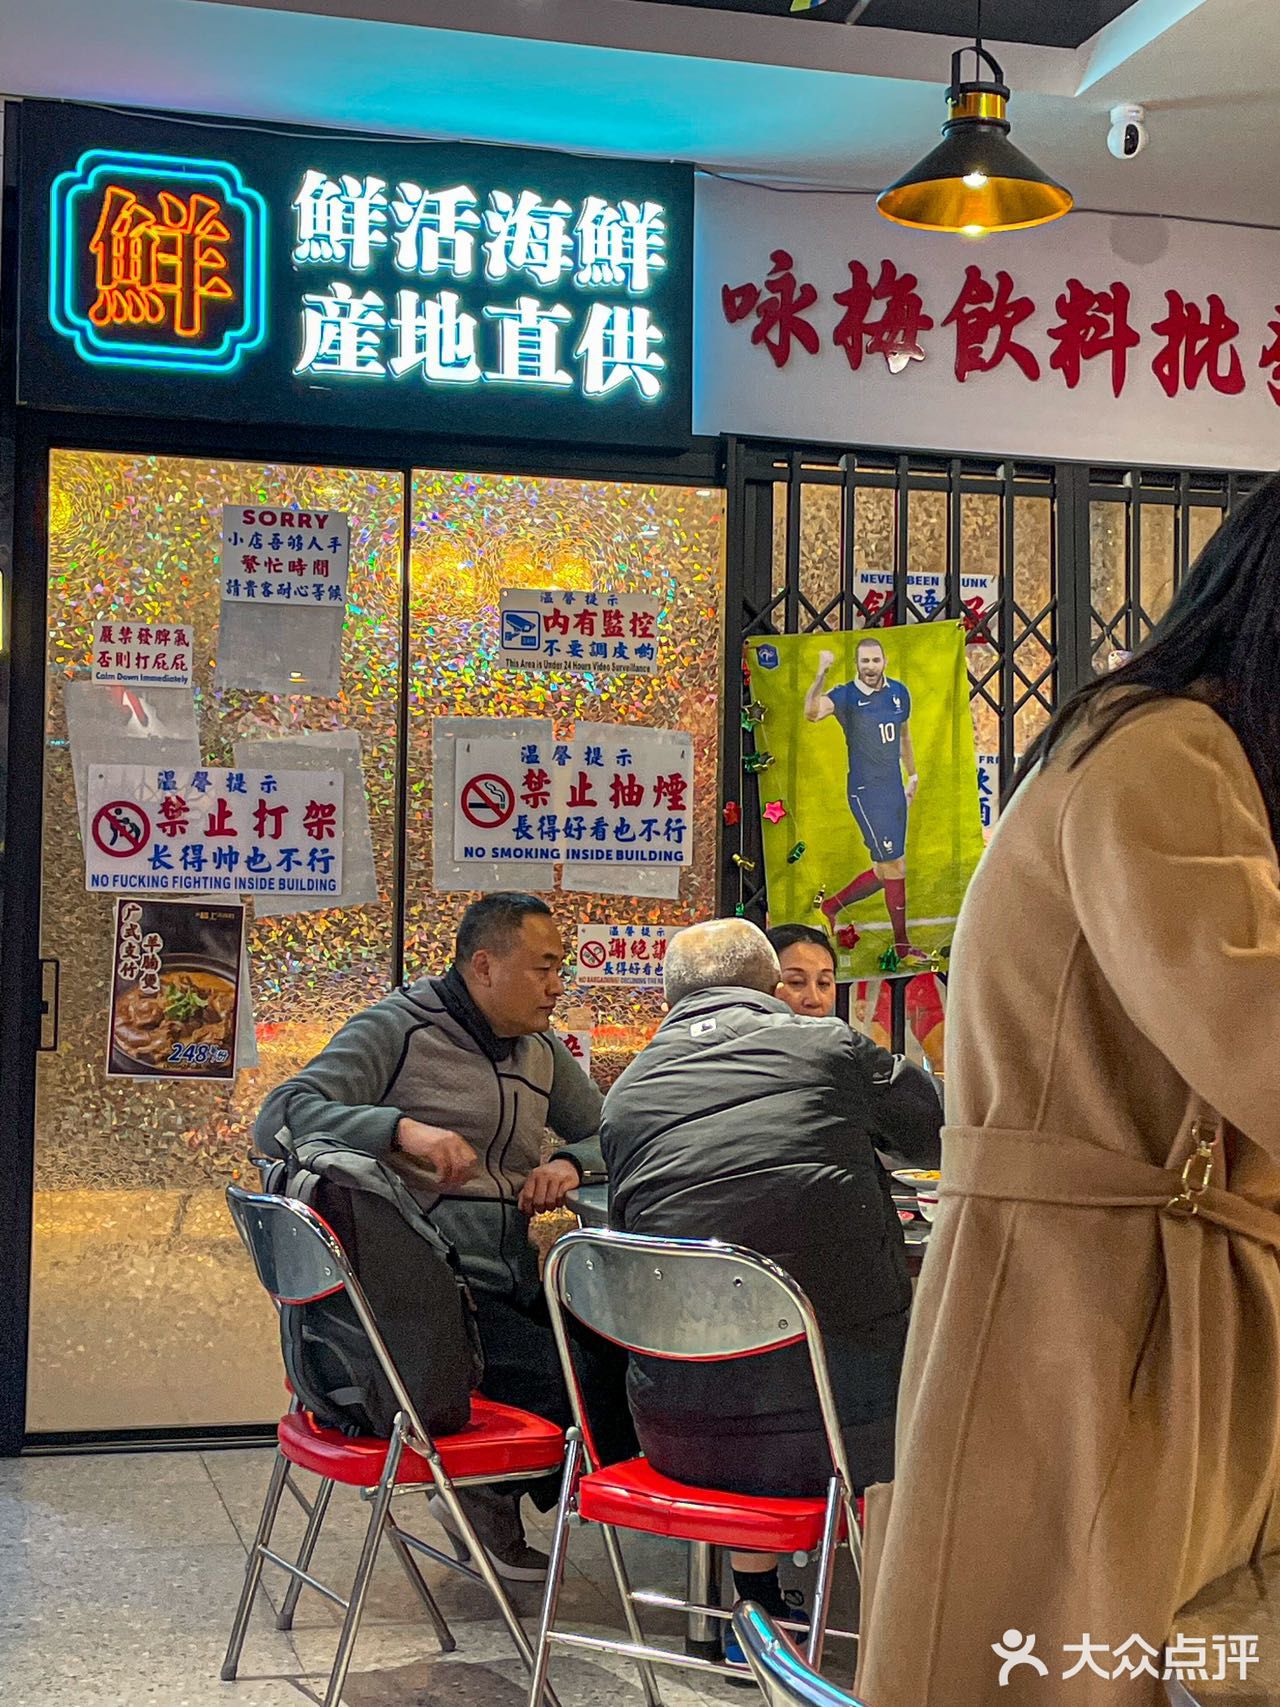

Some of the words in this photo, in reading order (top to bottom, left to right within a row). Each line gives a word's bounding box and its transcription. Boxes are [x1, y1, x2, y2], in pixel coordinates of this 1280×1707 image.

[290, 169, 668, 293] 鮮活海鮮
[90, 185, 233, 337] 鮮
[242, 509, 329, 529] SORRY
[906, 575, 939, 586] BEEN
[97, 650, 189, 671] 否則打屁屁
[506, 659, 519, 668] This
[520, 659, 535, 669] Area
[536, 660, 543, 669] is
[543, 660, 563, 670] Under
[564, 660, 572, 670] 24
[573, 661, 591, 671] Hours
[592, 662, 611, 672] Video
[611, 662, 651, 673] Surveillance
[878, 722, 895, 744] 10
[519, 768, 688, 812] 禁止抽煙
[156, 794, 337, 841] 禁止打架
[512, 815, 688, 843] 長得好看也不行
[147, 843, 335, 874] 长得帅也不行
[464, 846, 486, 858] NO
[491, 847, 561, 859] SMOKING
[566, 848, 612, 860] INSIDE
[615, 849, 684, 862] BUILDING
[91, 874, 109, 887] NO
[112, 875, 169, 889] FUCKING
[172, 876, 231, 890] FIGHTING
[234, 877, 275, 891] INSIDE
[278, 877, 337, 892] BUILDING
